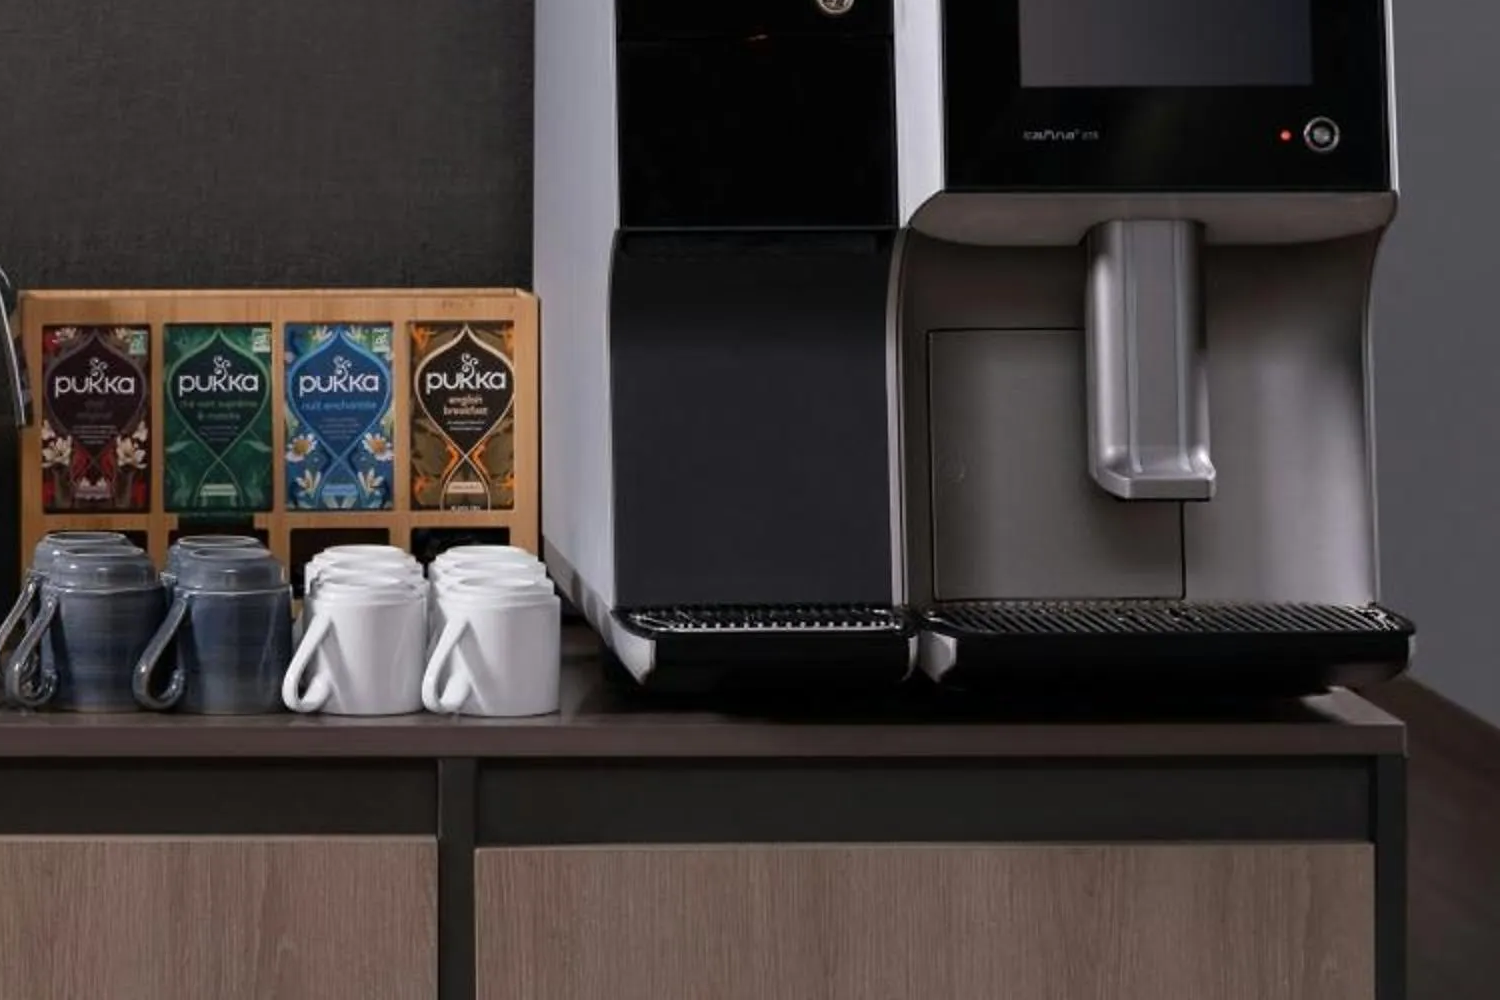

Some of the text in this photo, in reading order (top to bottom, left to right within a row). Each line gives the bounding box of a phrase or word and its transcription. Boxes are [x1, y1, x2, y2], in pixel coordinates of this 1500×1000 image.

[54, 356, 136, 399] pukka
[178, 355, 259, 397] pukka
[299, 355, 379, 397] pukka
[425, 353, 506, 395] pukka
